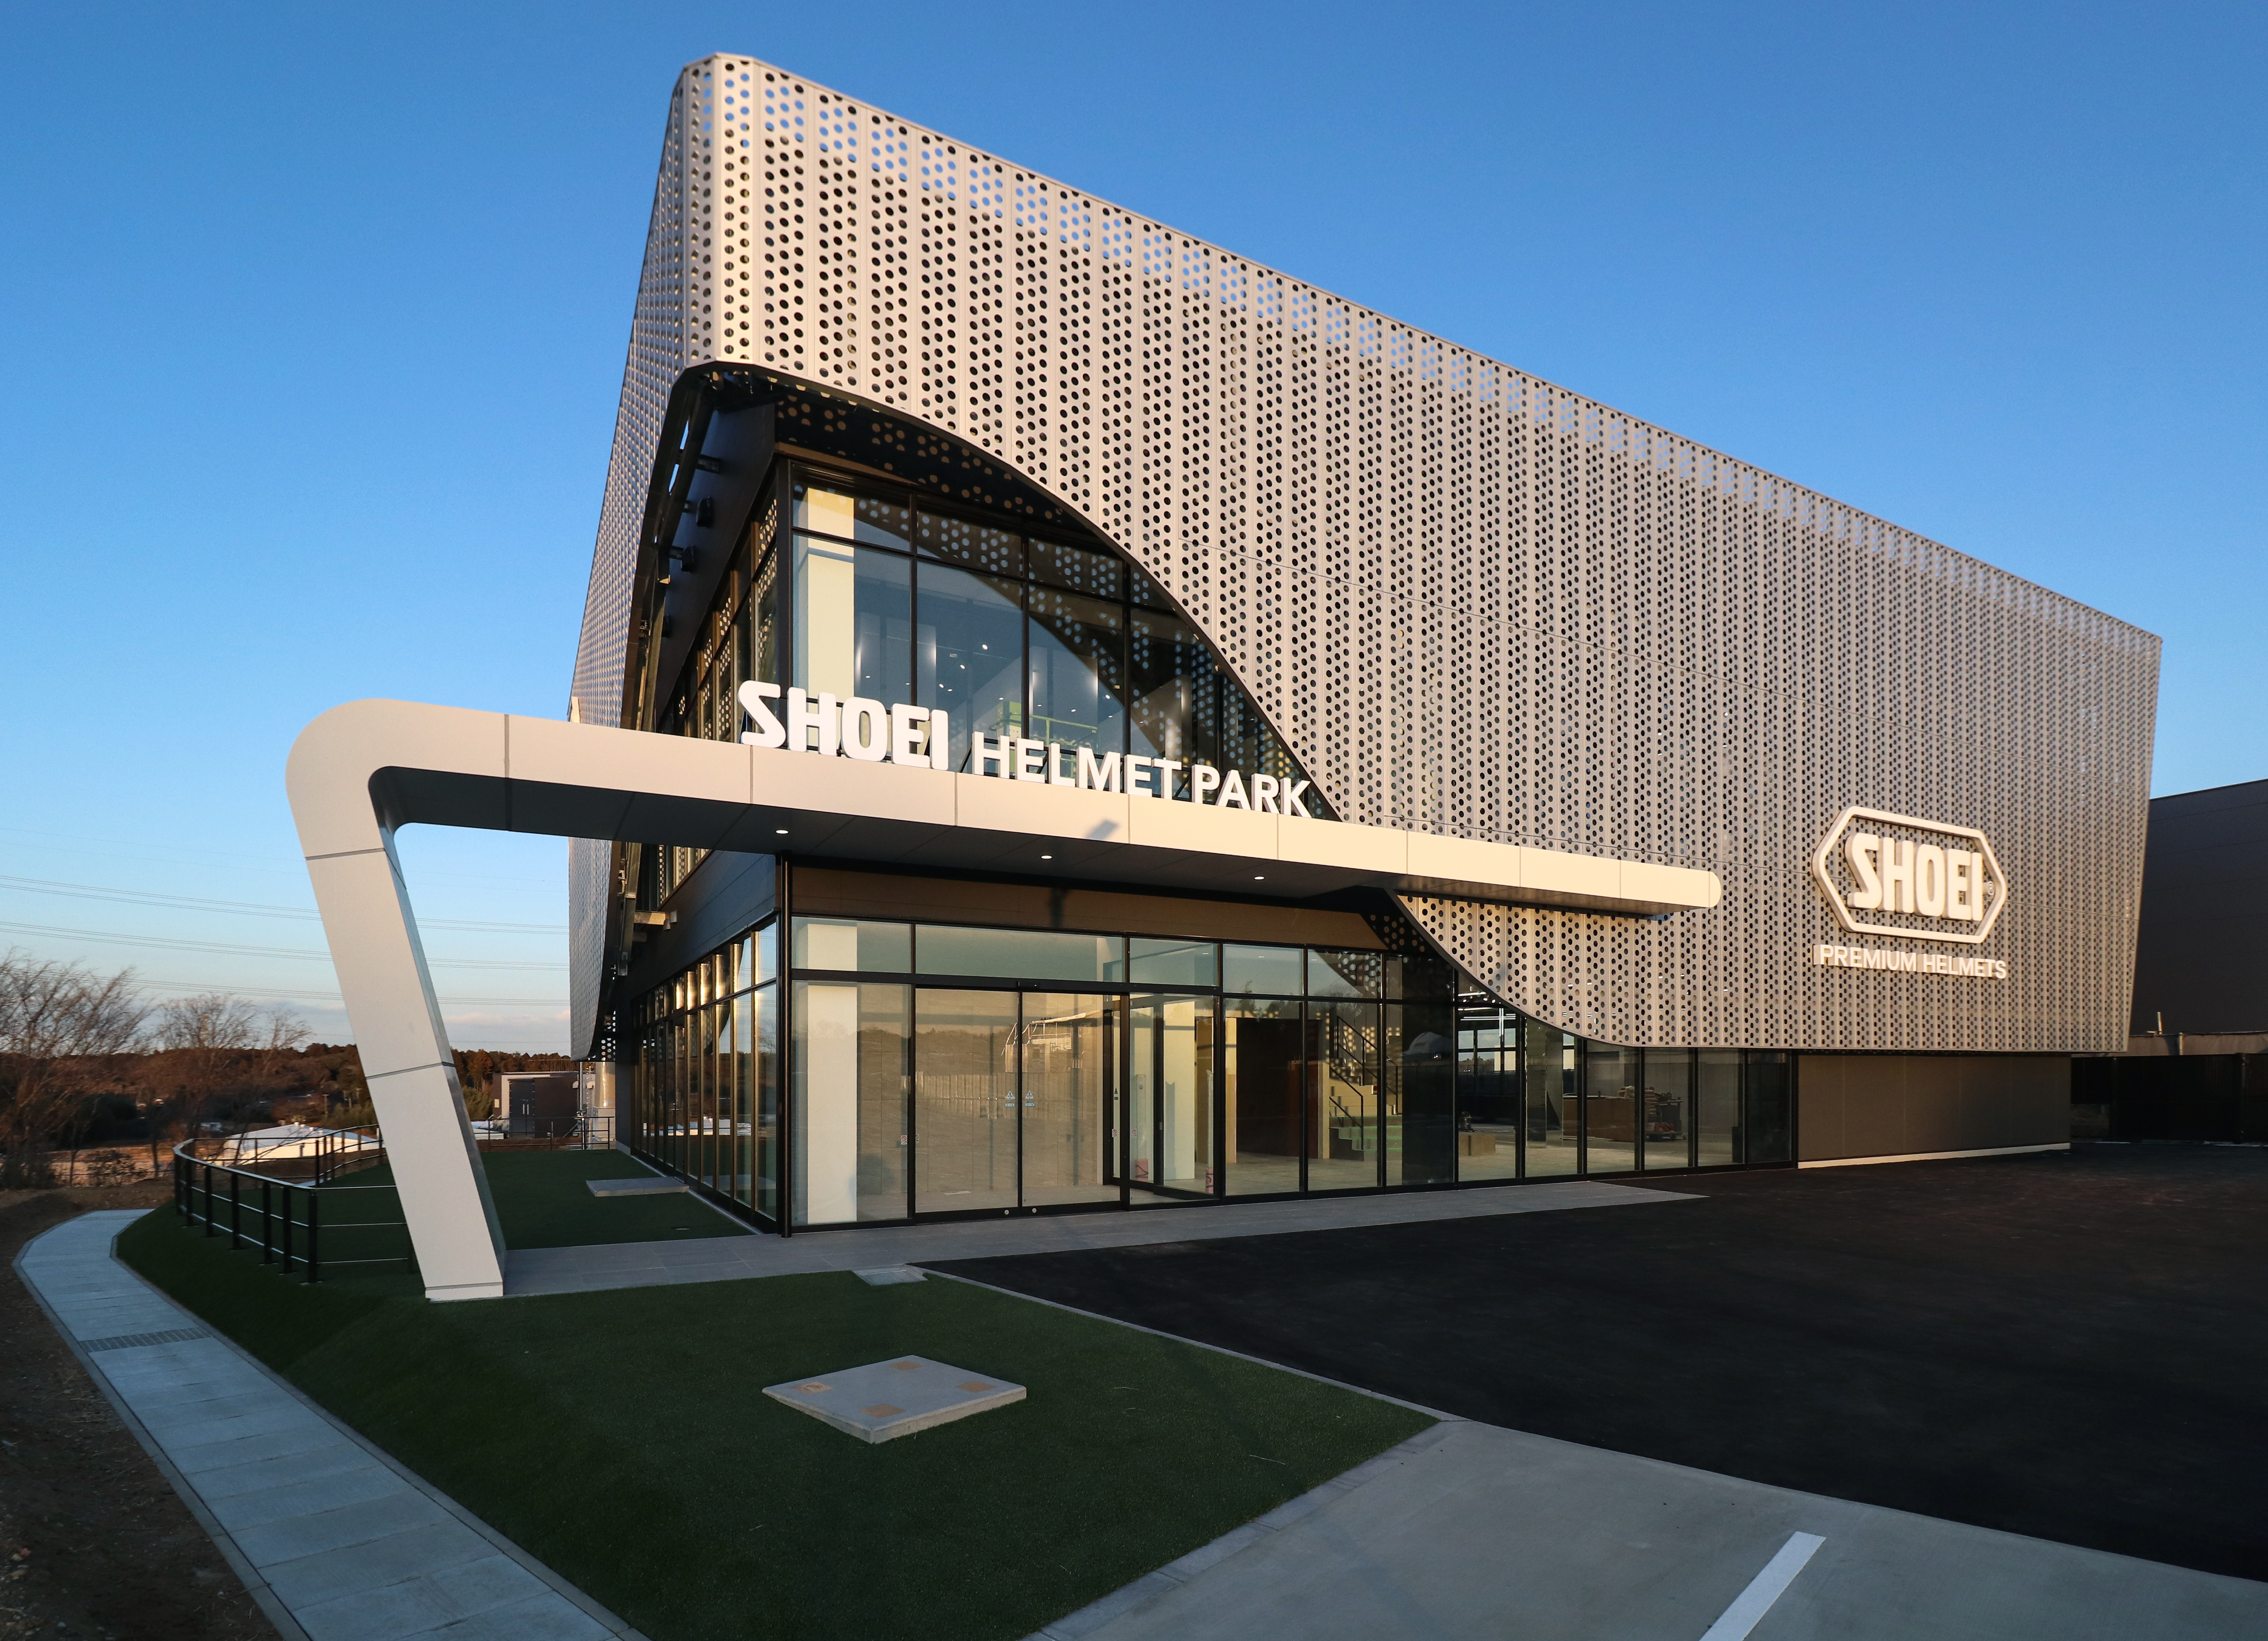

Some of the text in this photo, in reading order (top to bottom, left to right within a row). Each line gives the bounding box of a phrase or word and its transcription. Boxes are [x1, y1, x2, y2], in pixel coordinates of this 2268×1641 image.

[738, 680, 1312, 818] SHOEI HELMET PARK
[1846, 832, 1983, 921] SHOEI
[1818, 944, 2007, 979] PREMIUM HELMETS
